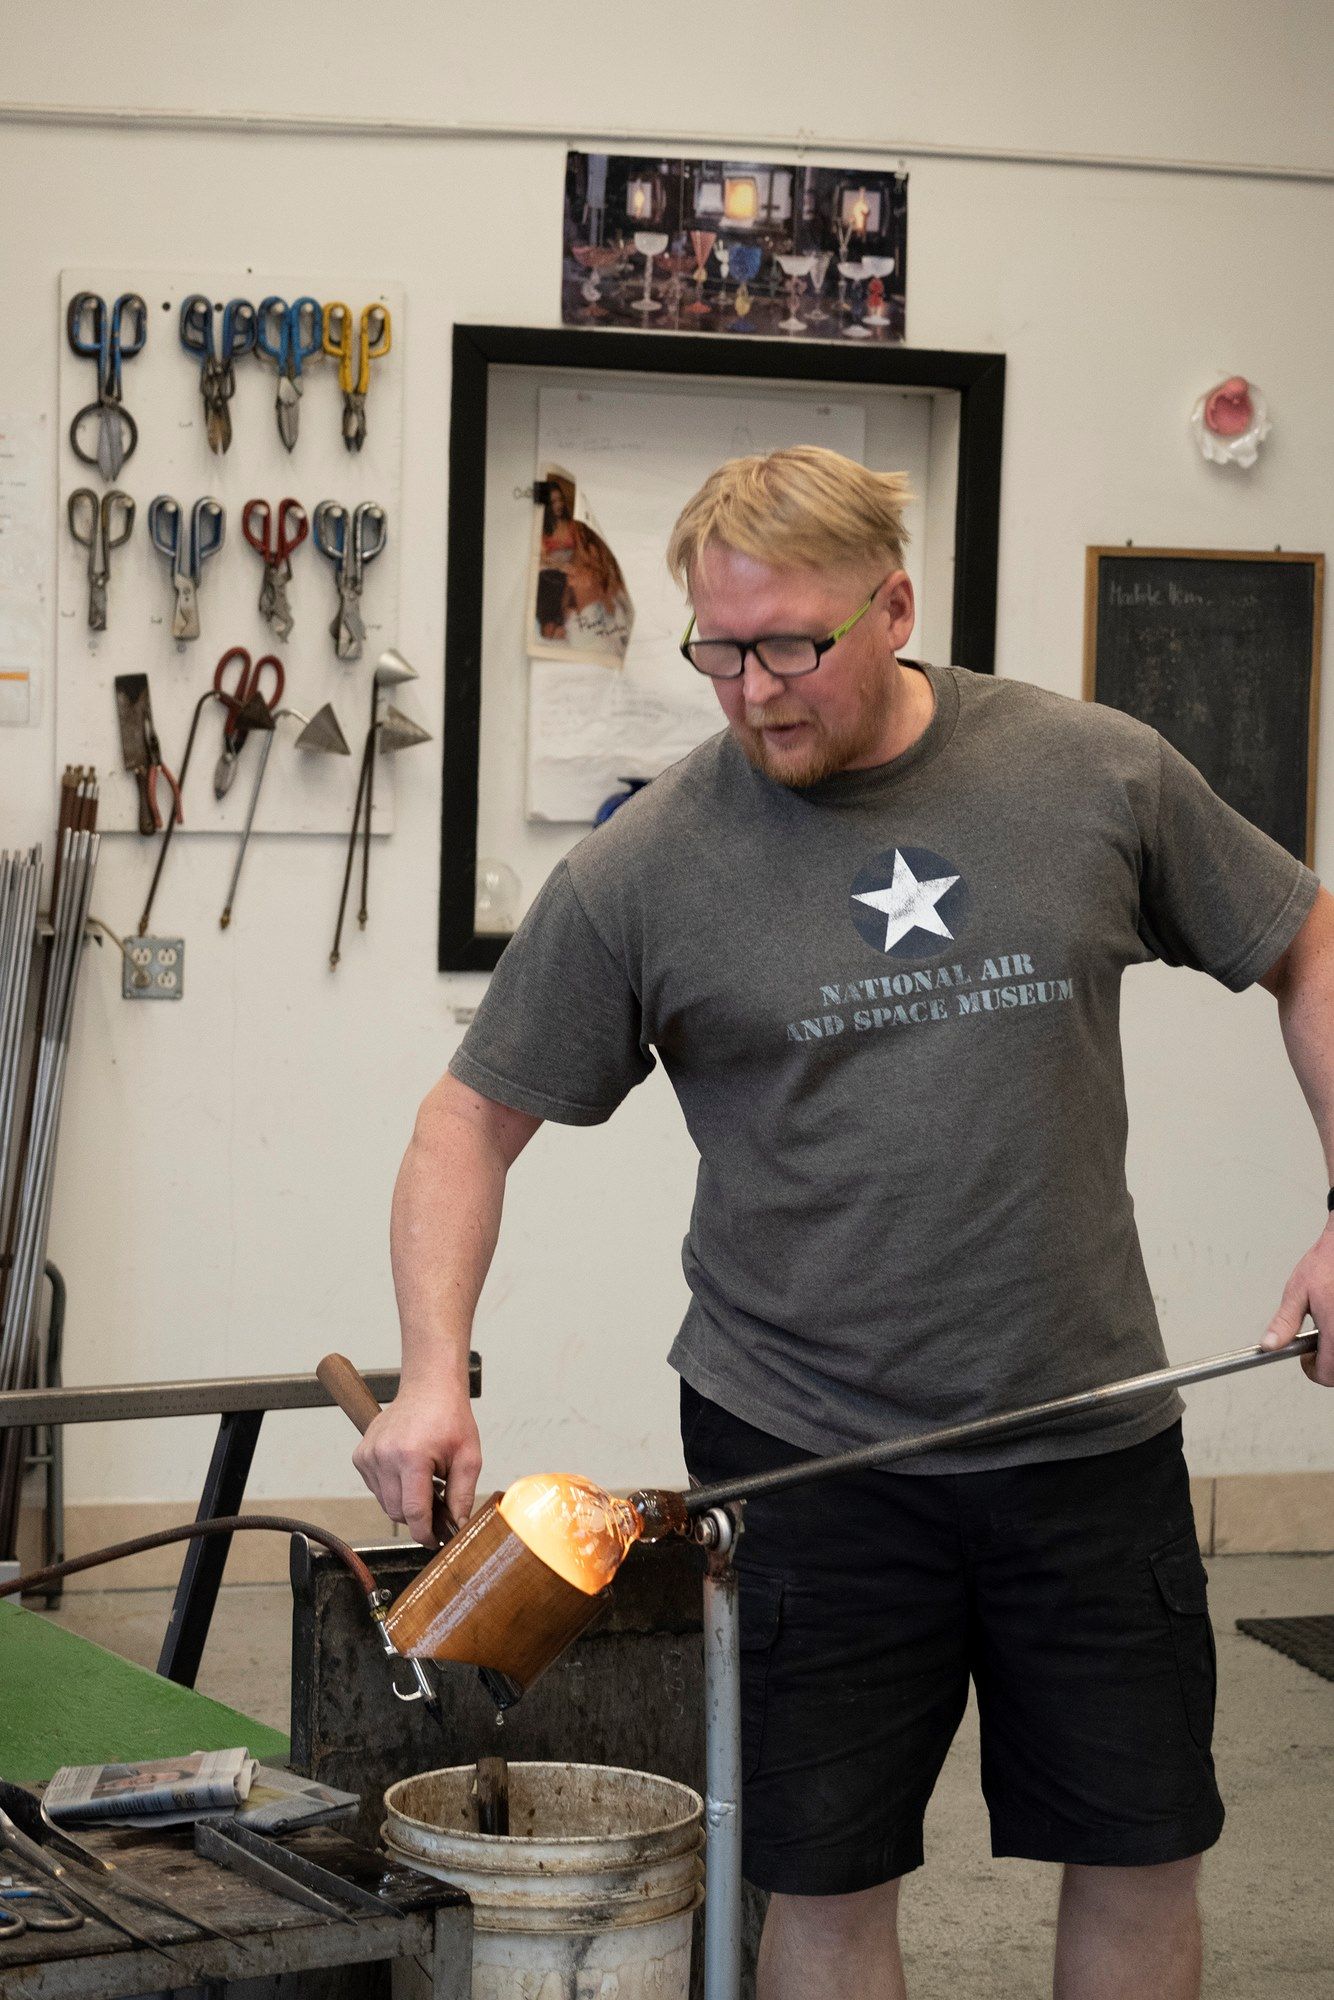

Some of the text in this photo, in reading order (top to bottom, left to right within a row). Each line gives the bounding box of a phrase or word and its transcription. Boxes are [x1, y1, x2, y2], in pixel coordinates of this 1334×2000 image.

[819, 953, 1034, 1006] NATIONAL AIR
[786, 978, 1074, 1043] AND SPACE MUSEUM
